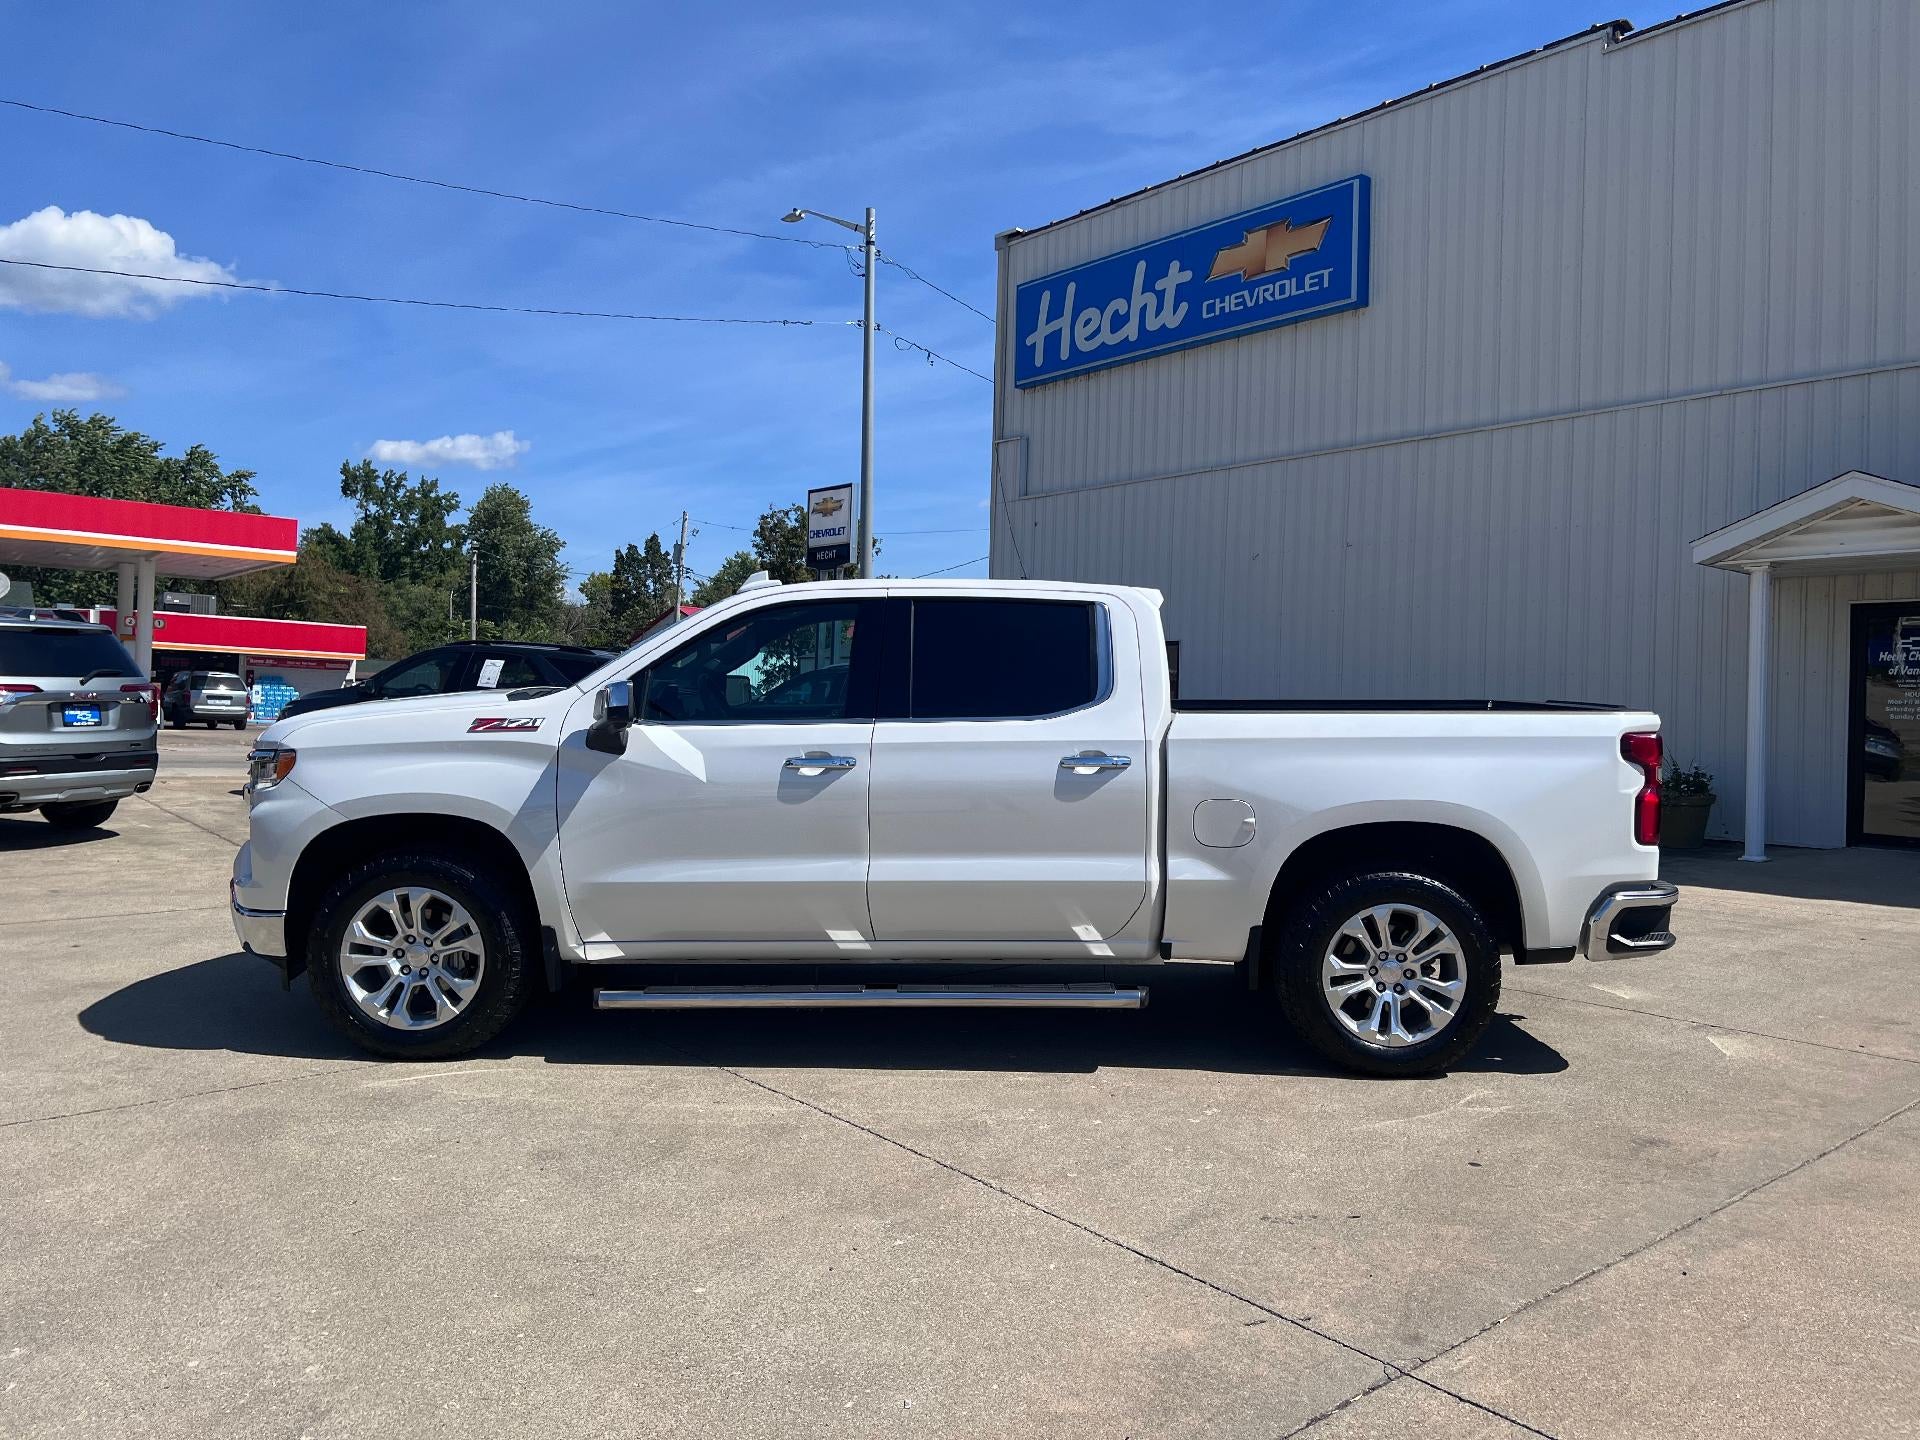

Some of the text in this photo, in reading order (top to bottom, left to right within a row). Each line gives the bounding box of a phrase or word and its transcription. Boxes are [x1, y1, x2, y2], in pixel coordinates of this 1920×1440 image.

[1202, 267, 1334, 320] CHEVROLET
[1025, 259, 1193, 368] Hecht
[809, 526, 846, 539] CHEVROLET
[816, 549, 837, 560] HECHT
